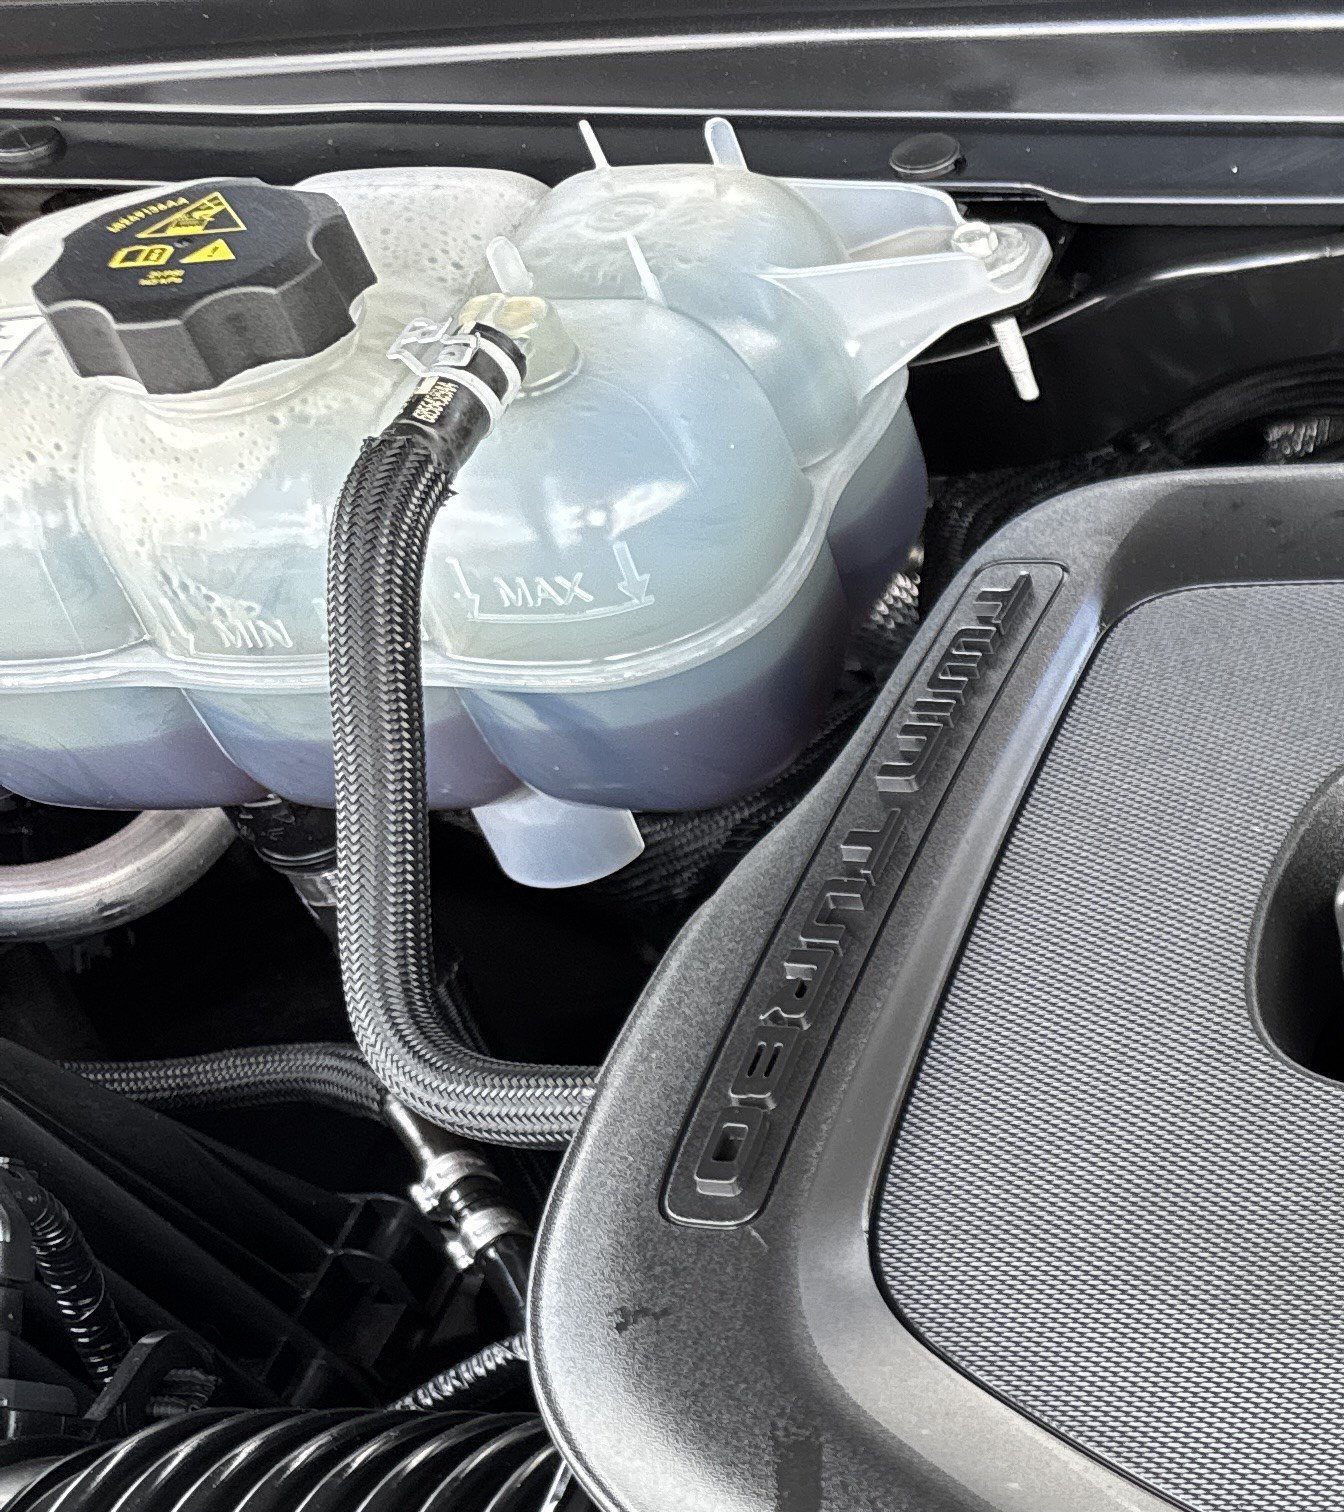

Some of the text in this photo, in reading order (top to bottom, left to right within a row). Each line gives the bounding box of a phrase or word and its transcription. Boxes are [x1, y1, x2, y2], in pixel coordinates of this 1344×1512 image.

[493, 572, 593, 606] MAX
[212, 618, 293, 648] MIN
[695, 570, 1034, 1197] TWIN TURBO
